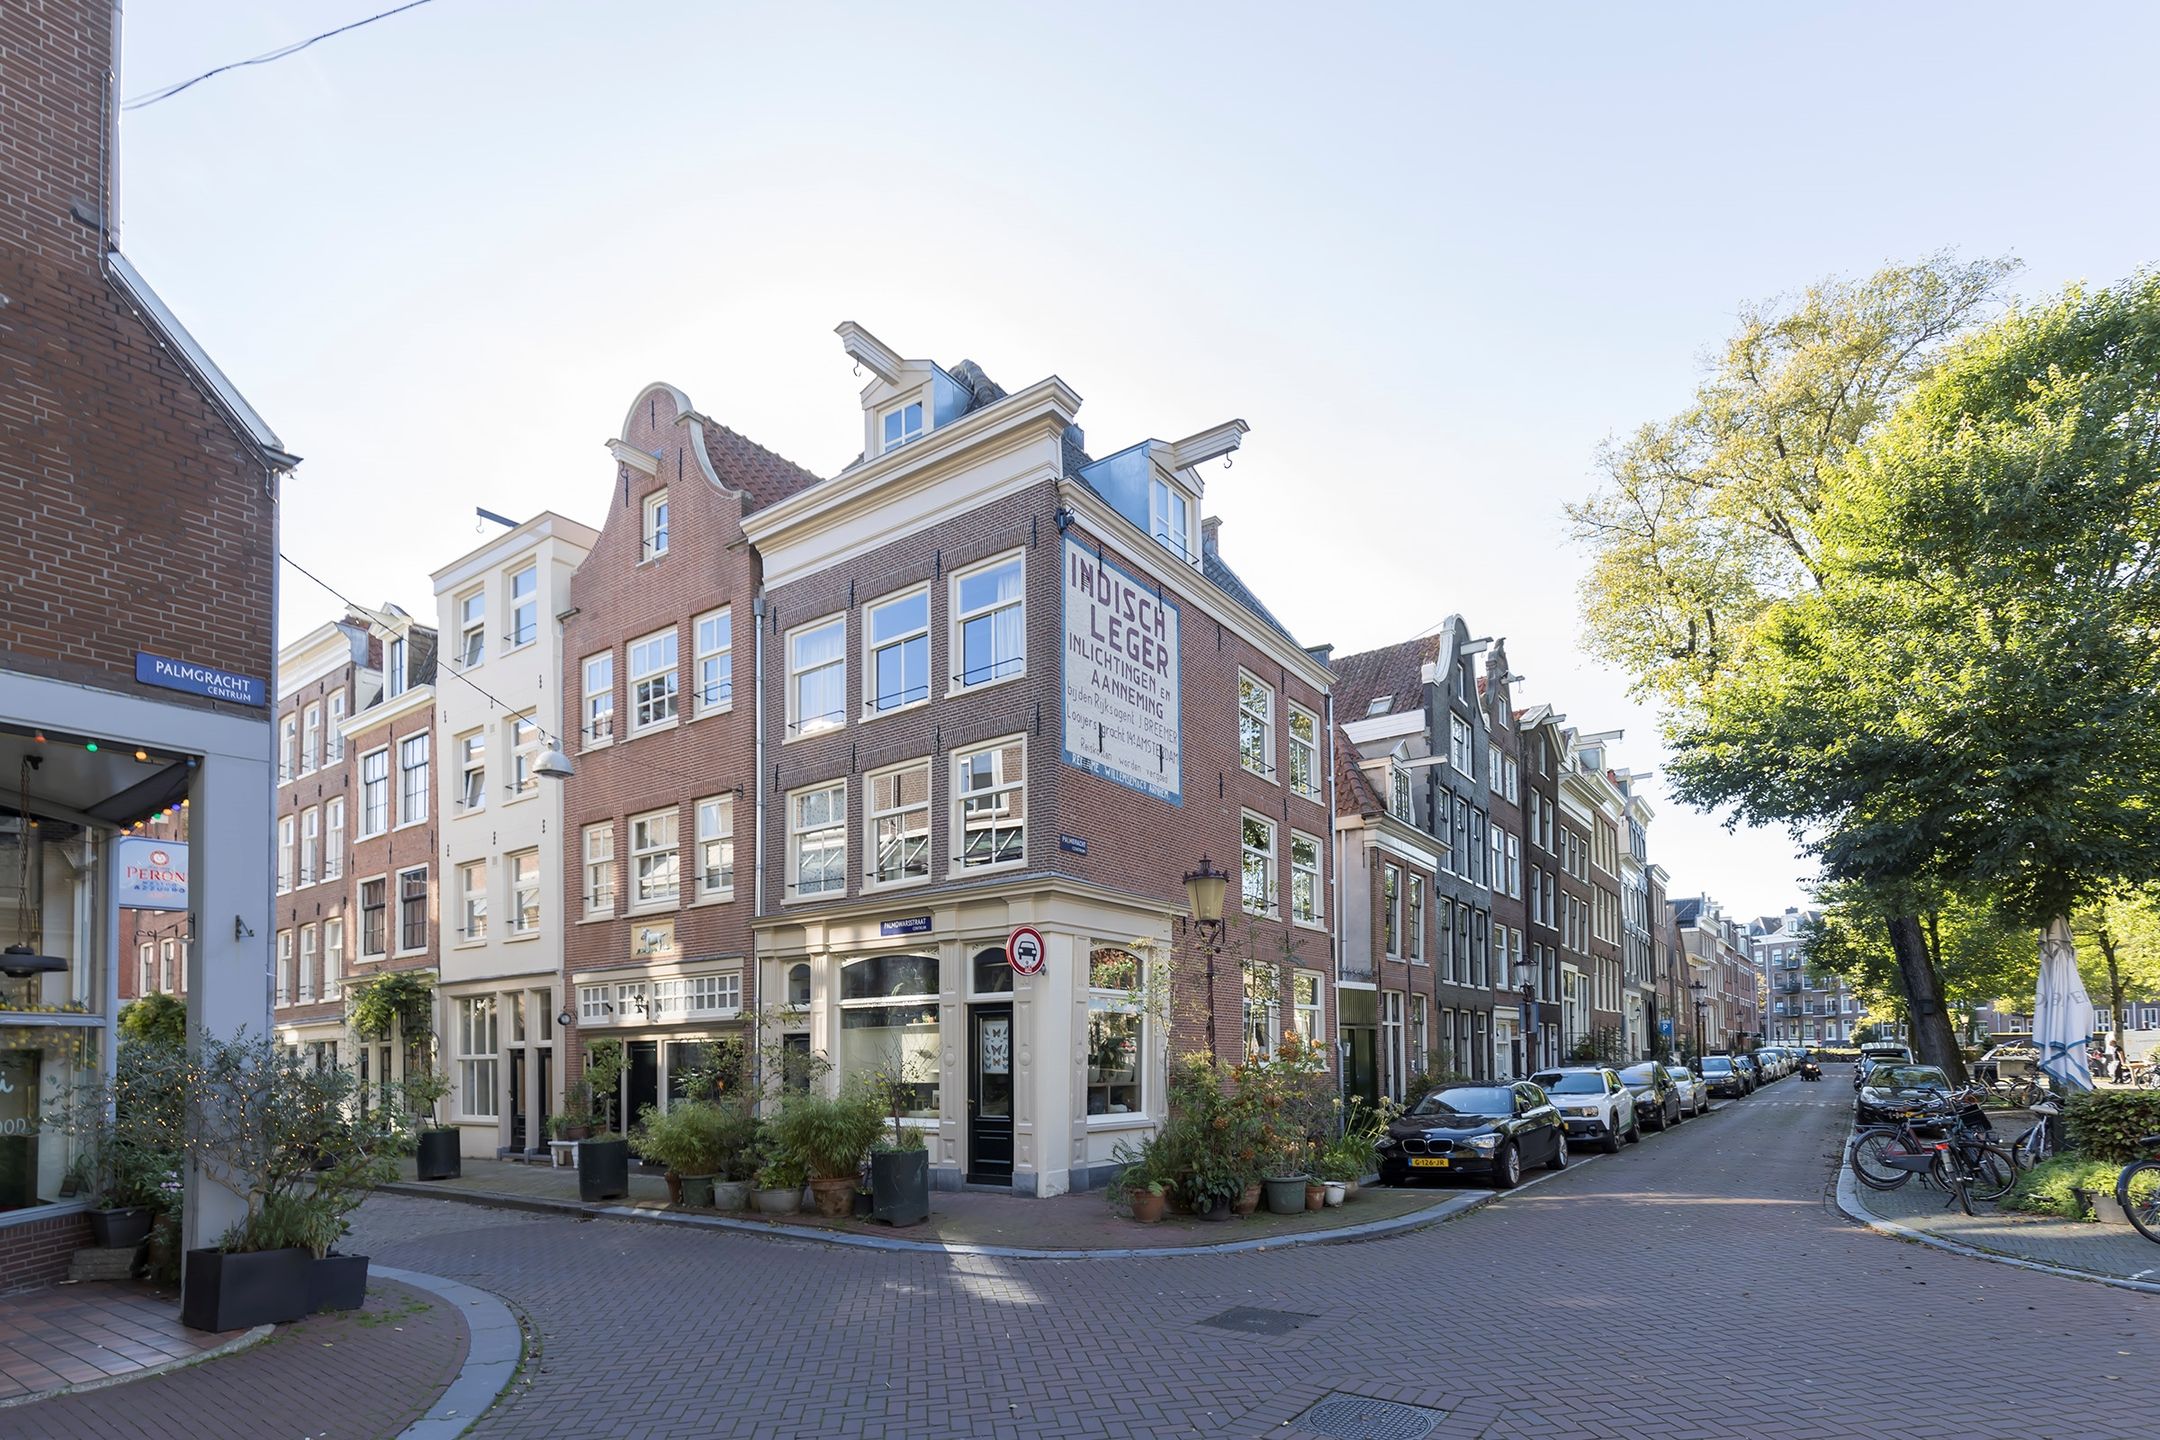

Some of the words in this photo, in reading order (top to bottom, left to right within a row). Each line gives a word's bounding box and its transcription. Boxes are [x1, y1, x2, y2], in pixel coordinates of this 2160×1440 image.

[1072, 552, 1165, 642] INDISCH
[1070, 632, 1156, 694] INLICHTINGEN
[1091, 604, 1168, 678] LEGER
[156, 661, 251, 692] PALMGRACHT
[207, 686, 251, 702] CENTRUM
[1091, 669, 1164, 719] AANNEMING
[128, 866, 186, 882] PERON
